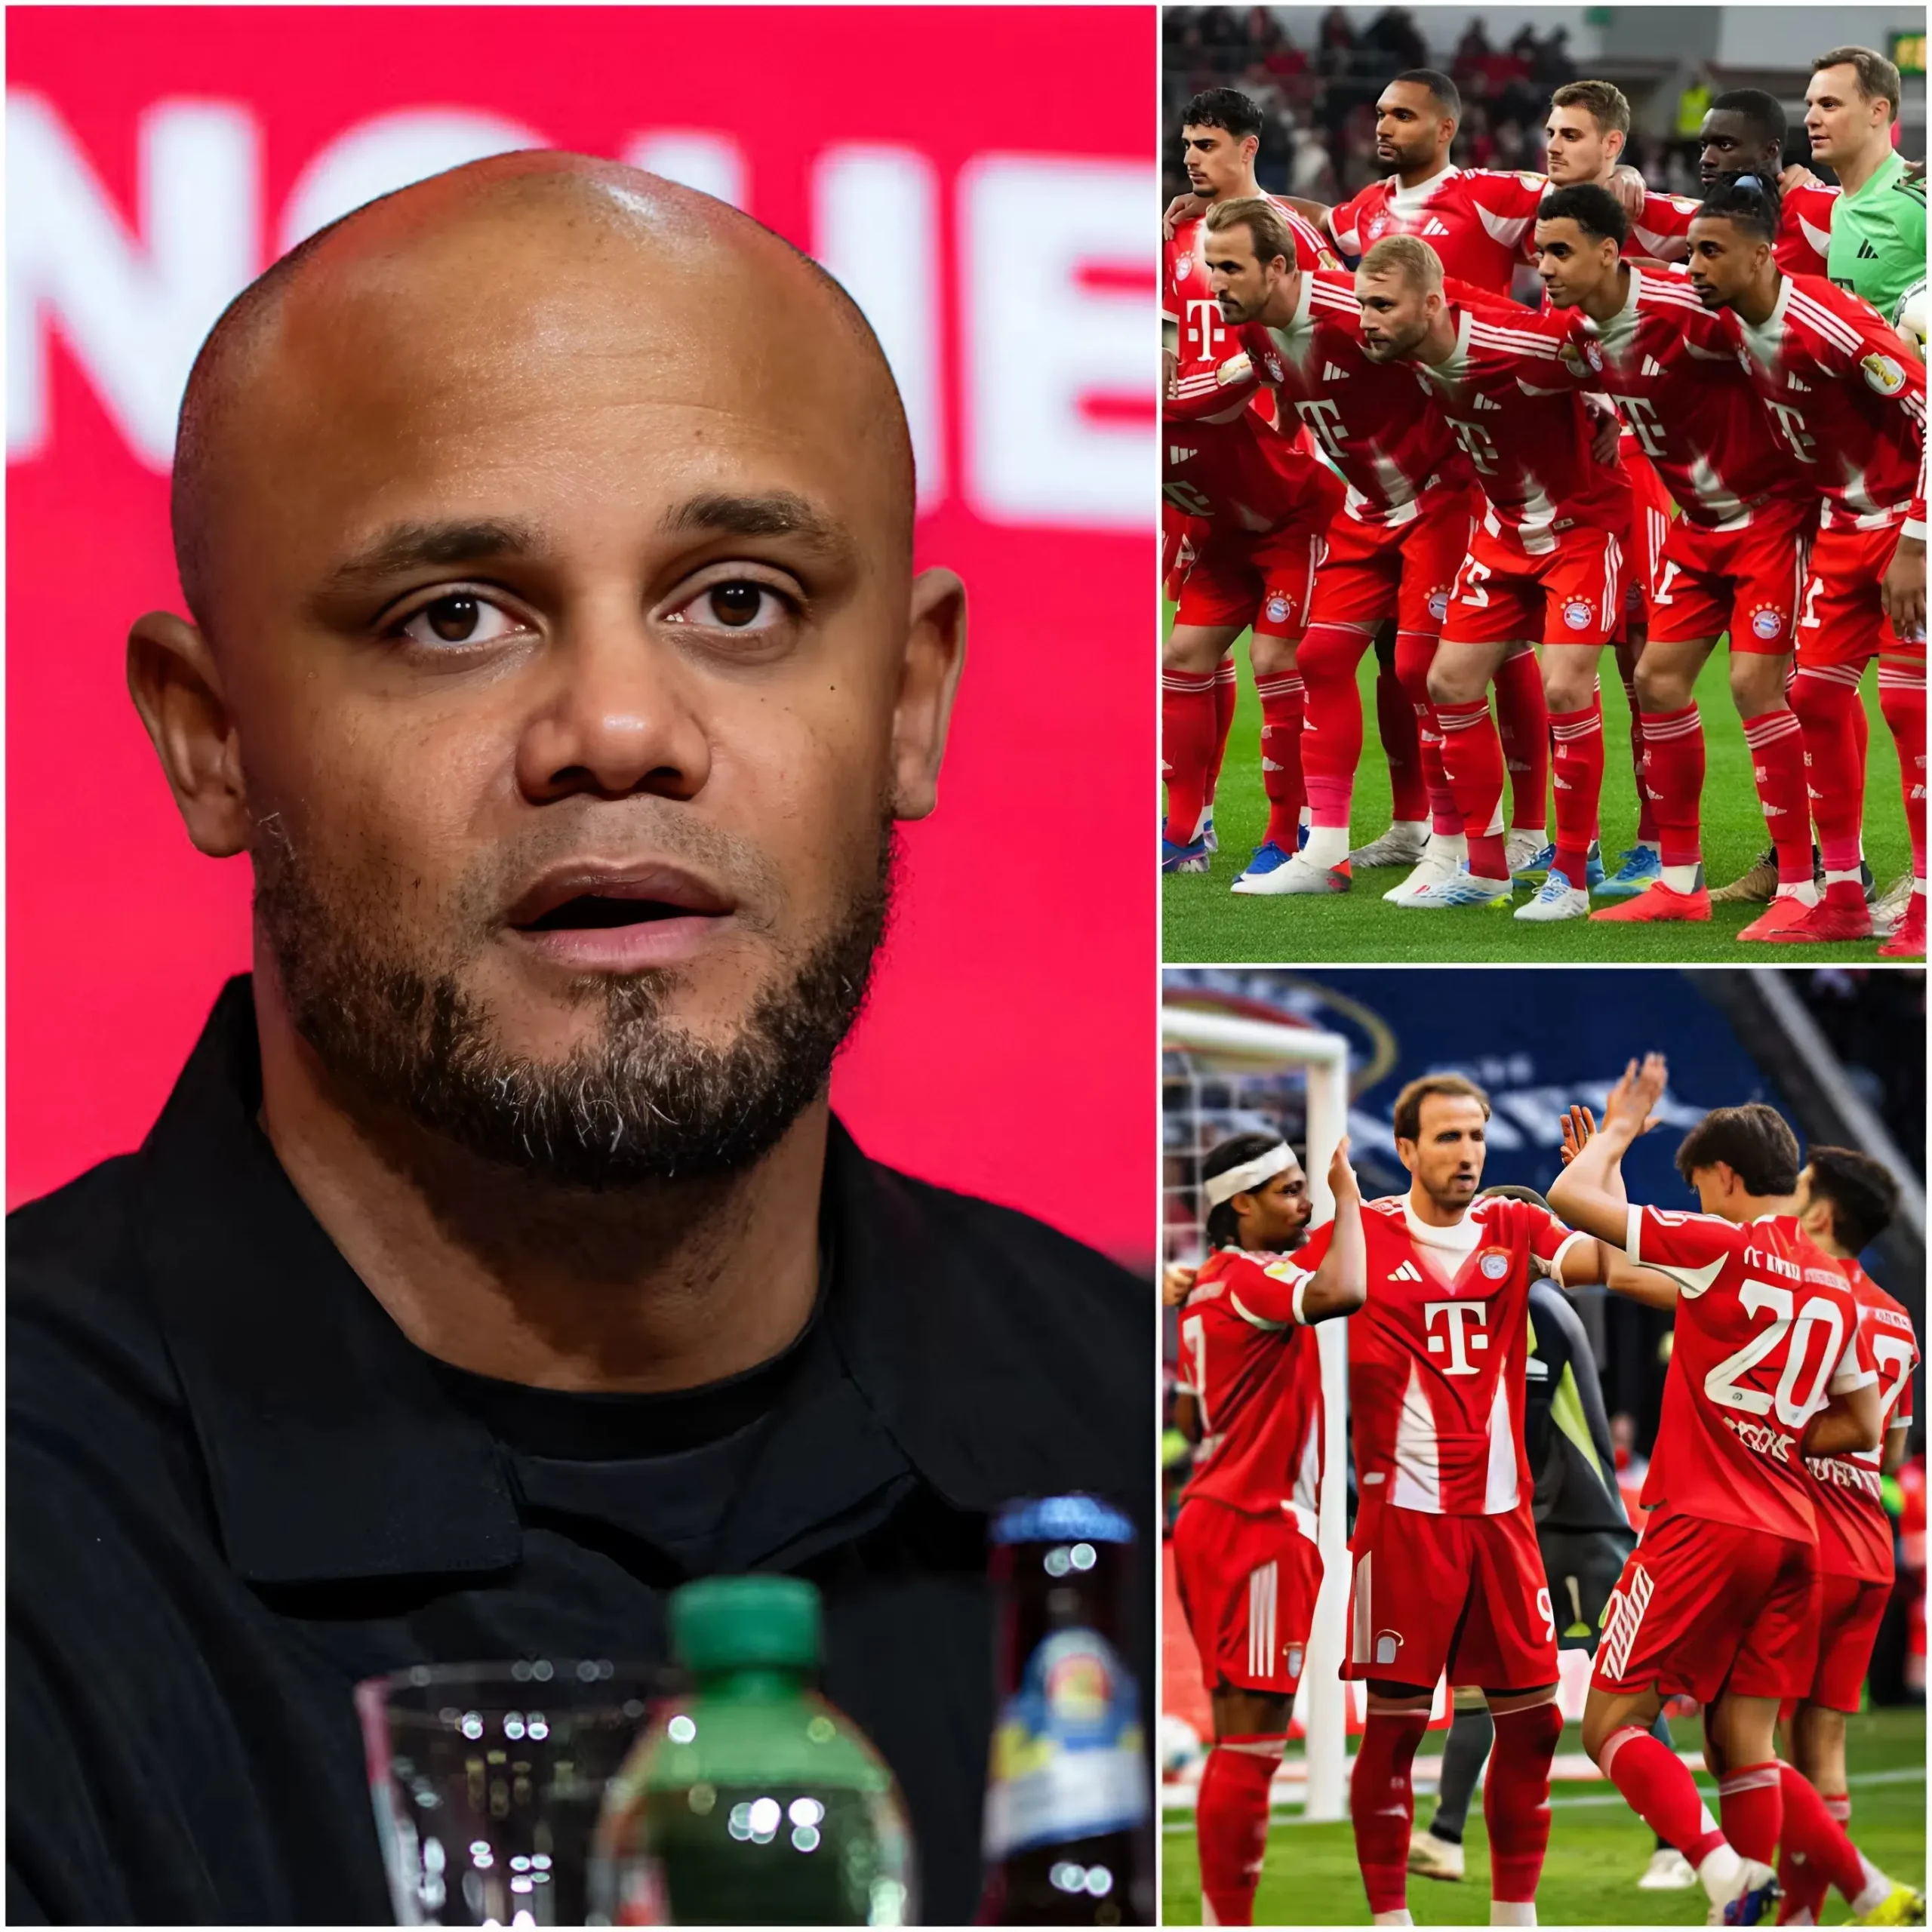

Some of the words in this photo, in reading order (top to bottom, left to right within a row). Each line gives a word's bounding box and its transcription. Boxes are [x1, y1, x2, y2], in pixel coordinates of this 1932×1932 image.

[1187, 300, 1226, 361] T
[1294, 400, 1349, 457] T
[1445, 416, 1498, 475] T
[1612, 395, 1666, 456] T
[1764, 398, 1817, 463] T
[1425, 1303, 1489, 1375] T
[1705, 1279, 1844, 1428] 20
